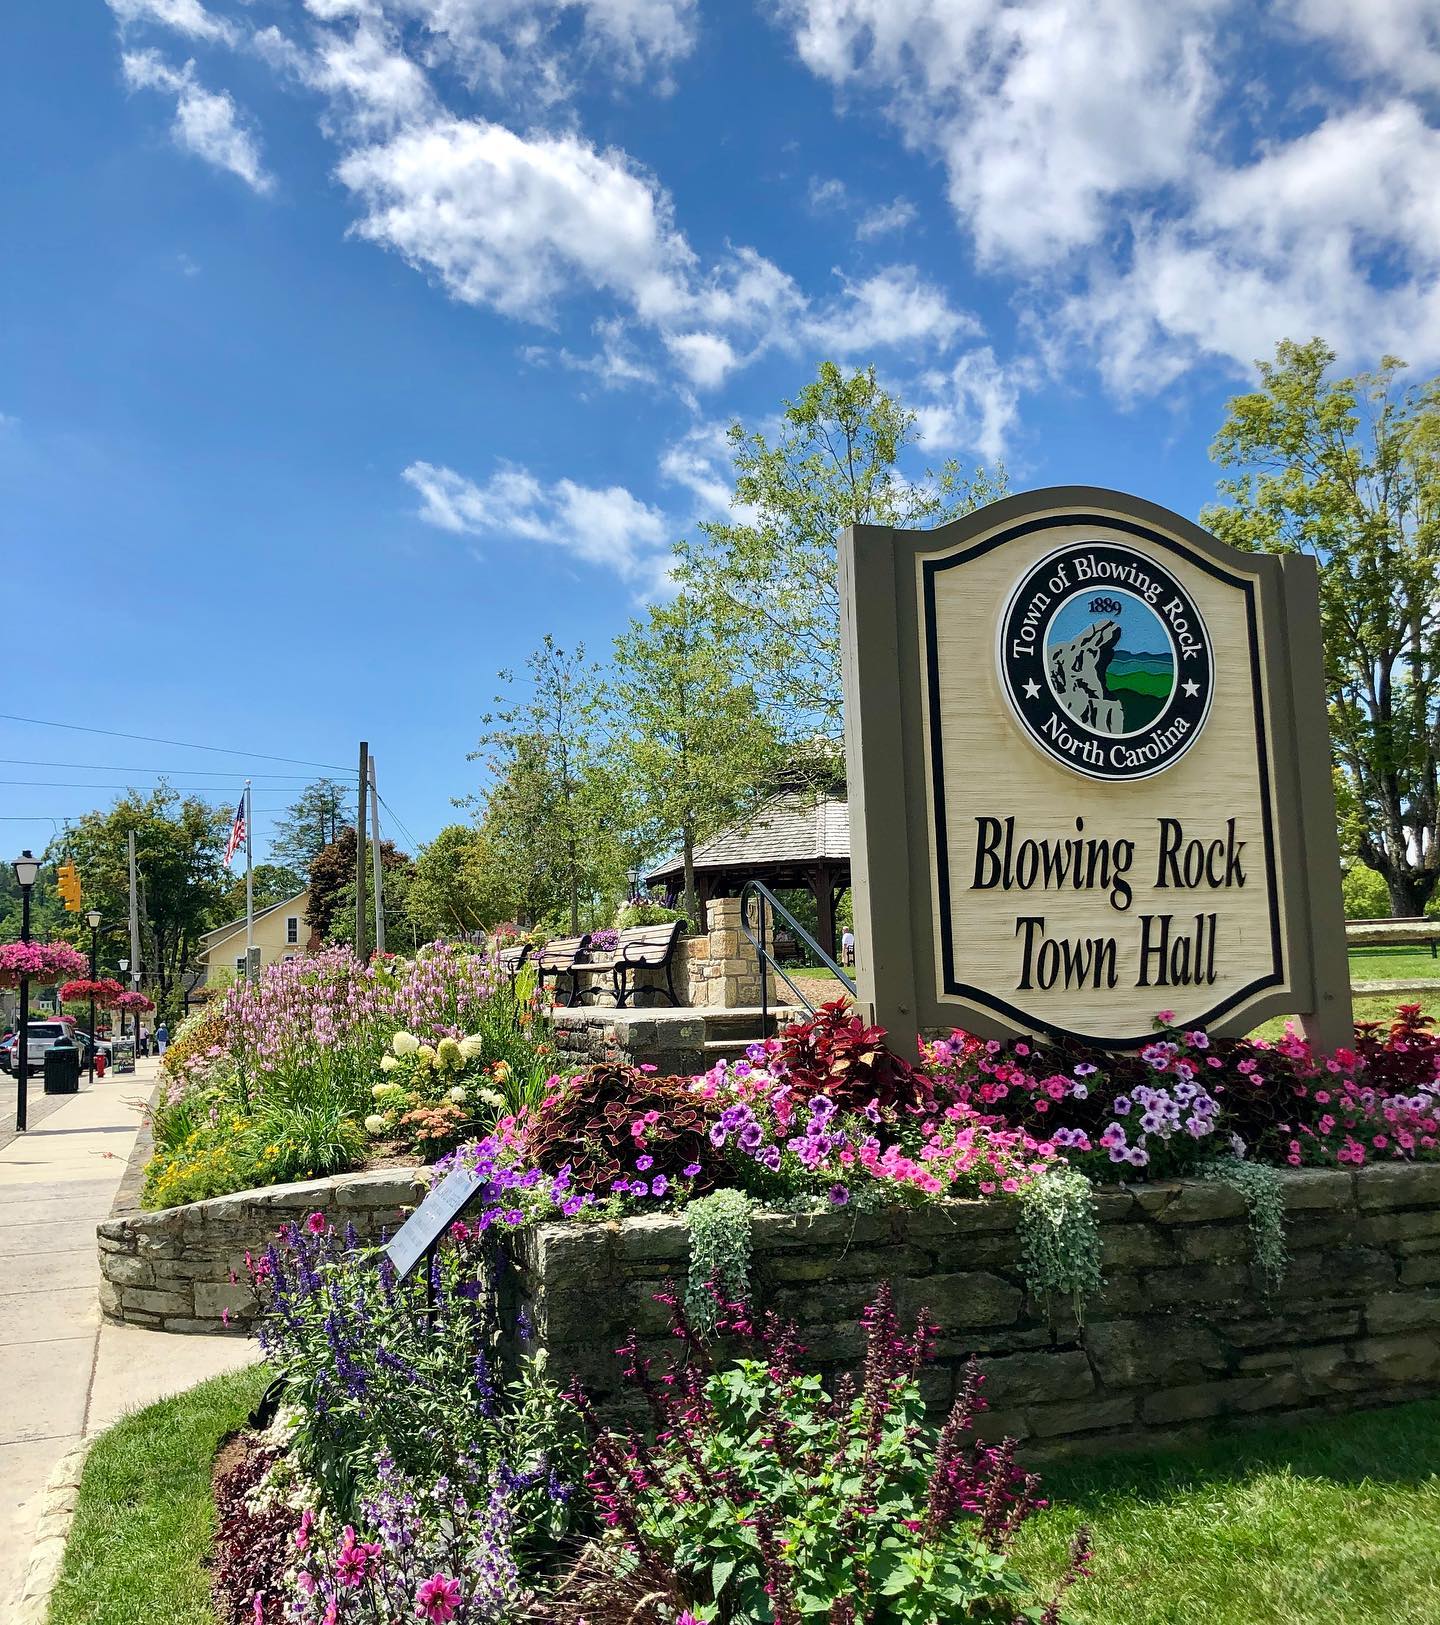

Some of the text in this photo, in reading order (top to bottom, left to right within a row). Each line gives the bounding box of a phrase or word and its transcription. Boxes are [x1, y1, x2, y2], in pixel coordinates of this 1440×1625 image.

[1013, 554, 1203, 661] Town of Blowing Rock
[1088, 597, 1122, 616] 1889
[1040, 712, 1191, 769] North Carolina
[969, 816, 1247, 911] Blowing Rock
[1015, 912, 1217, 990] Town Hall
